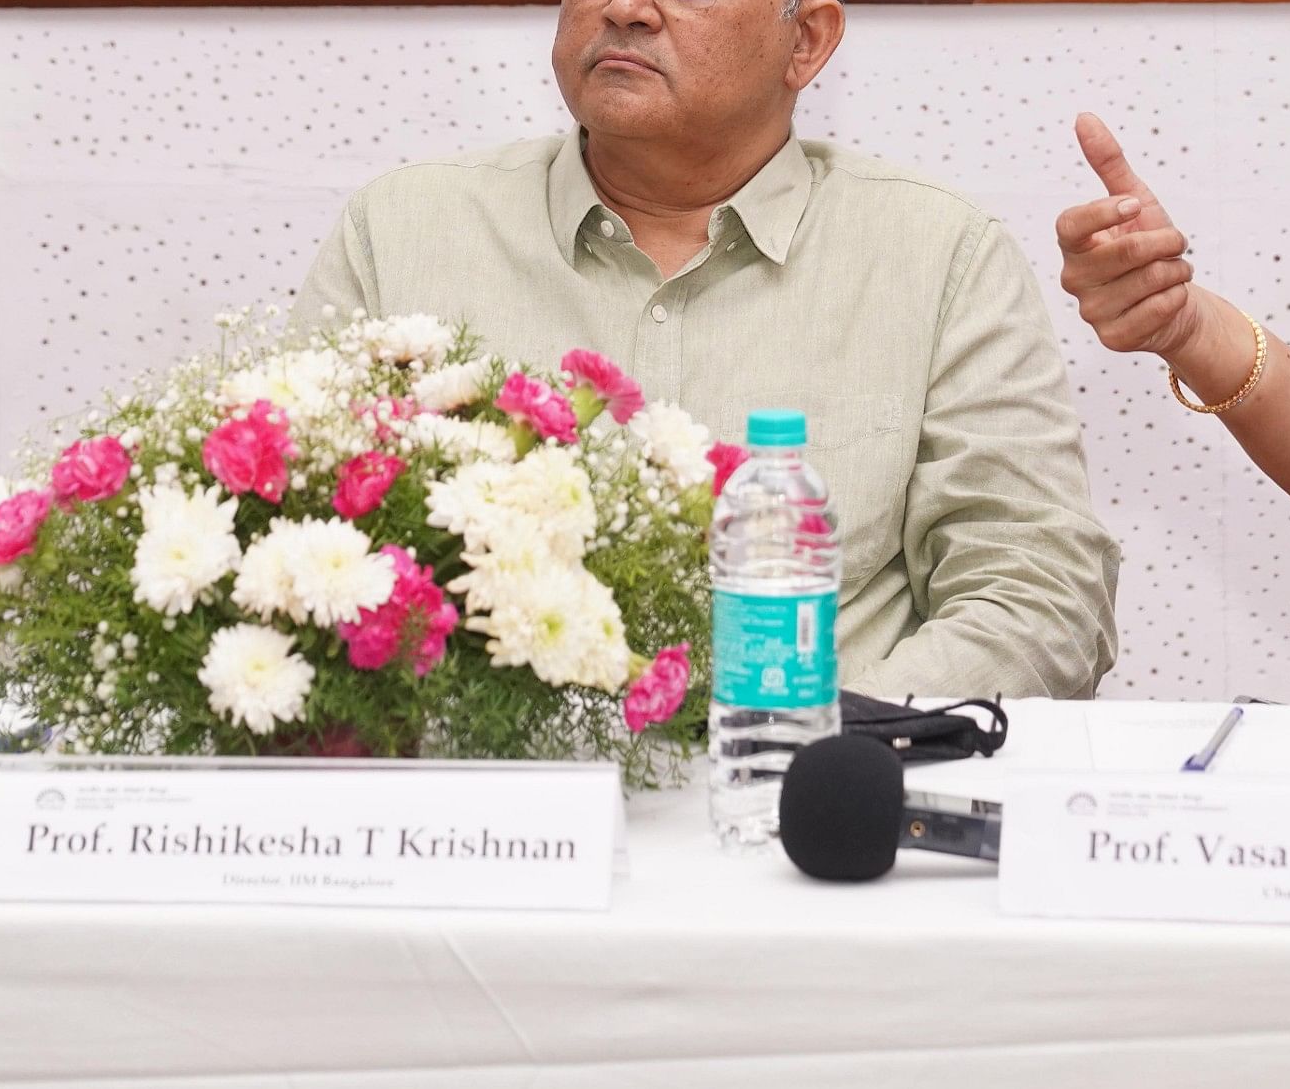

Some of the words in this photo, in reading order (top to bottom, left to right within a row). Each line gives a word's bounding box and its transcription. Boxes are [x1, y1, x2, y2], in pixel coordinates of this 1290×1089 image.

[25, 822, 113, 857] Prof.
[129, 822, 343, 858] Rishikesha
[356, 826, 385, 859] T
[397, 826, 578, 862] Krishnan
[1087, 829, 1179, 865] Prof.
[289, 872, 318, 889] IIM
[322, 873, 396, 892] Bangalore
